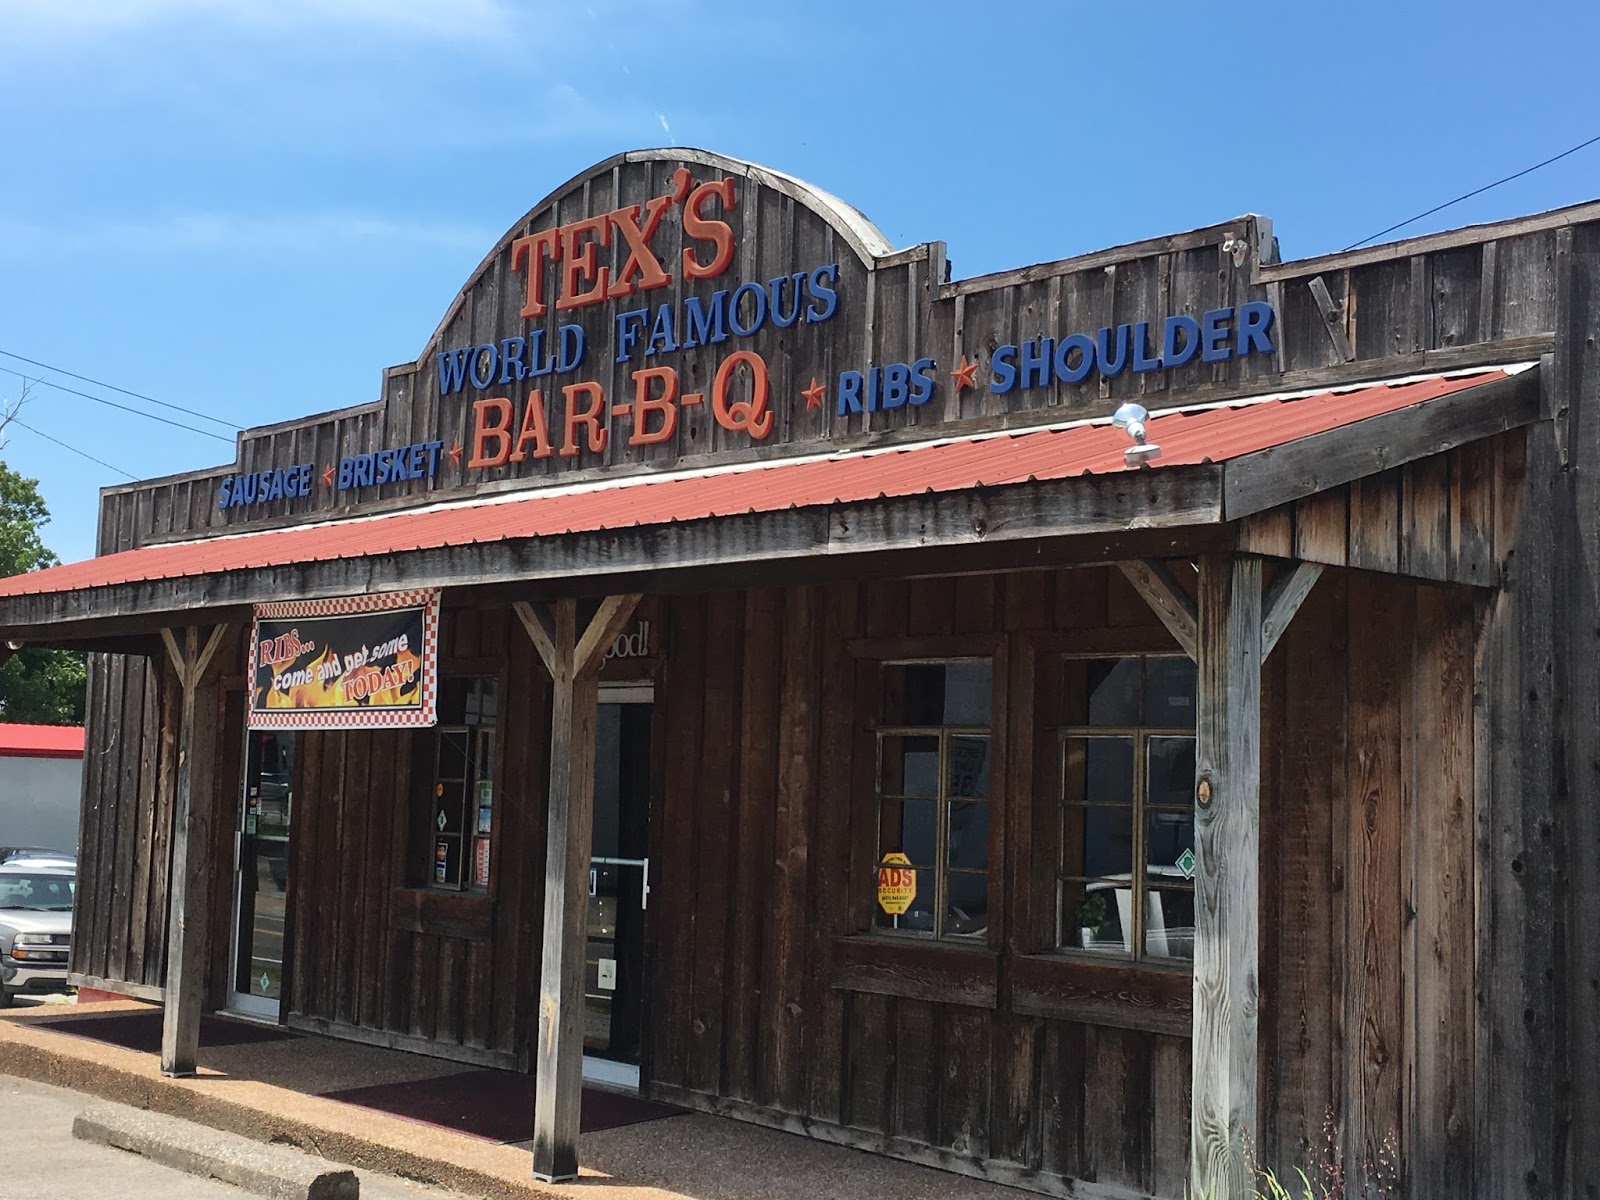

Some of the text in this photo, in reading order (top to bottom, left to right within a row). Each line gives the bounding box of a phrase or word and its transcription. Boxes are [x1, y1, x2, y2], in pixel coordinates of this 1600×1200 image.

[511, 167, 737, 319] TEX'S
[436, 264, 840, 396] WORLD FAMOUS
[837, 301, 1275, 416] RIBS SHOULDER
[467, 351, 774, 469] BAR-B-Q
[217, 440, 444, 510] SAUSAGE BRISKET
[273, 633, 409, 691] come and get some
[342, 659, 415, 703] TODAY!
[878, 868, 913, 887] ADS
